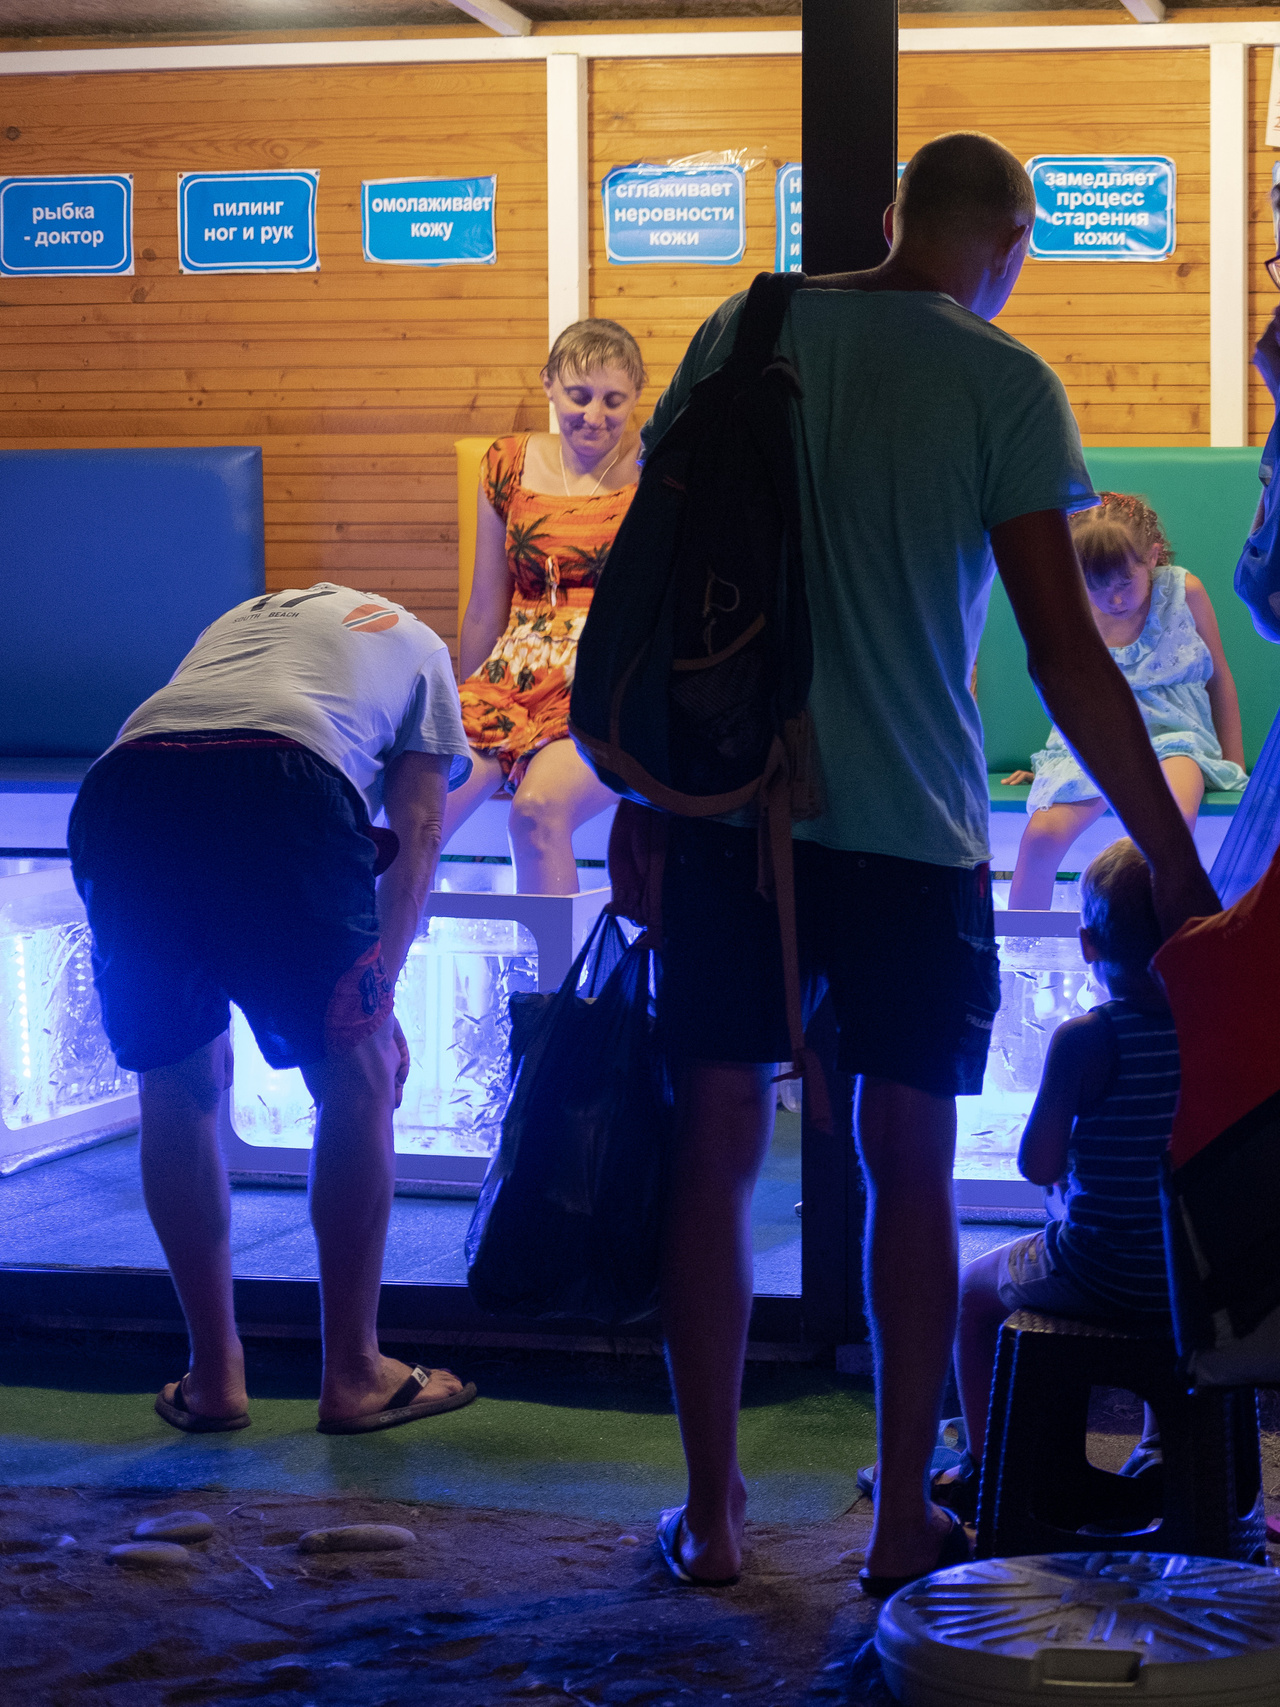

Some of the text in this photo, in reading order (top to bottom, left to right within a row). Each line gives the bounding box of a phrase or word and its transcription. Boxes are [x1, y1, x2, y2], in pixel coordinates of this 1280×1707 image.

[1044, 172, 1157, 189] замедляет
[616, 182, 733, 199] сглаживает
[213, 201, 285, 217] пилинг
[371, 196, 492, 213] омолаживает
[1056, 192, 1145, 210] процесс
[32, 202, 95, 225] рыбка
[614, 206, 735, 226] неровности
[1051, 211, 1150, 230] старения
[34, 229, 104, 248] доктор
[204, 225, 294, 245] ног и рук
[410, 222, 454, 242] кожу
[649, 231, 700, 246] кожи
[1073, 231, 1126, 246] кожи
[232, 613, 262, 624] SOUTH
